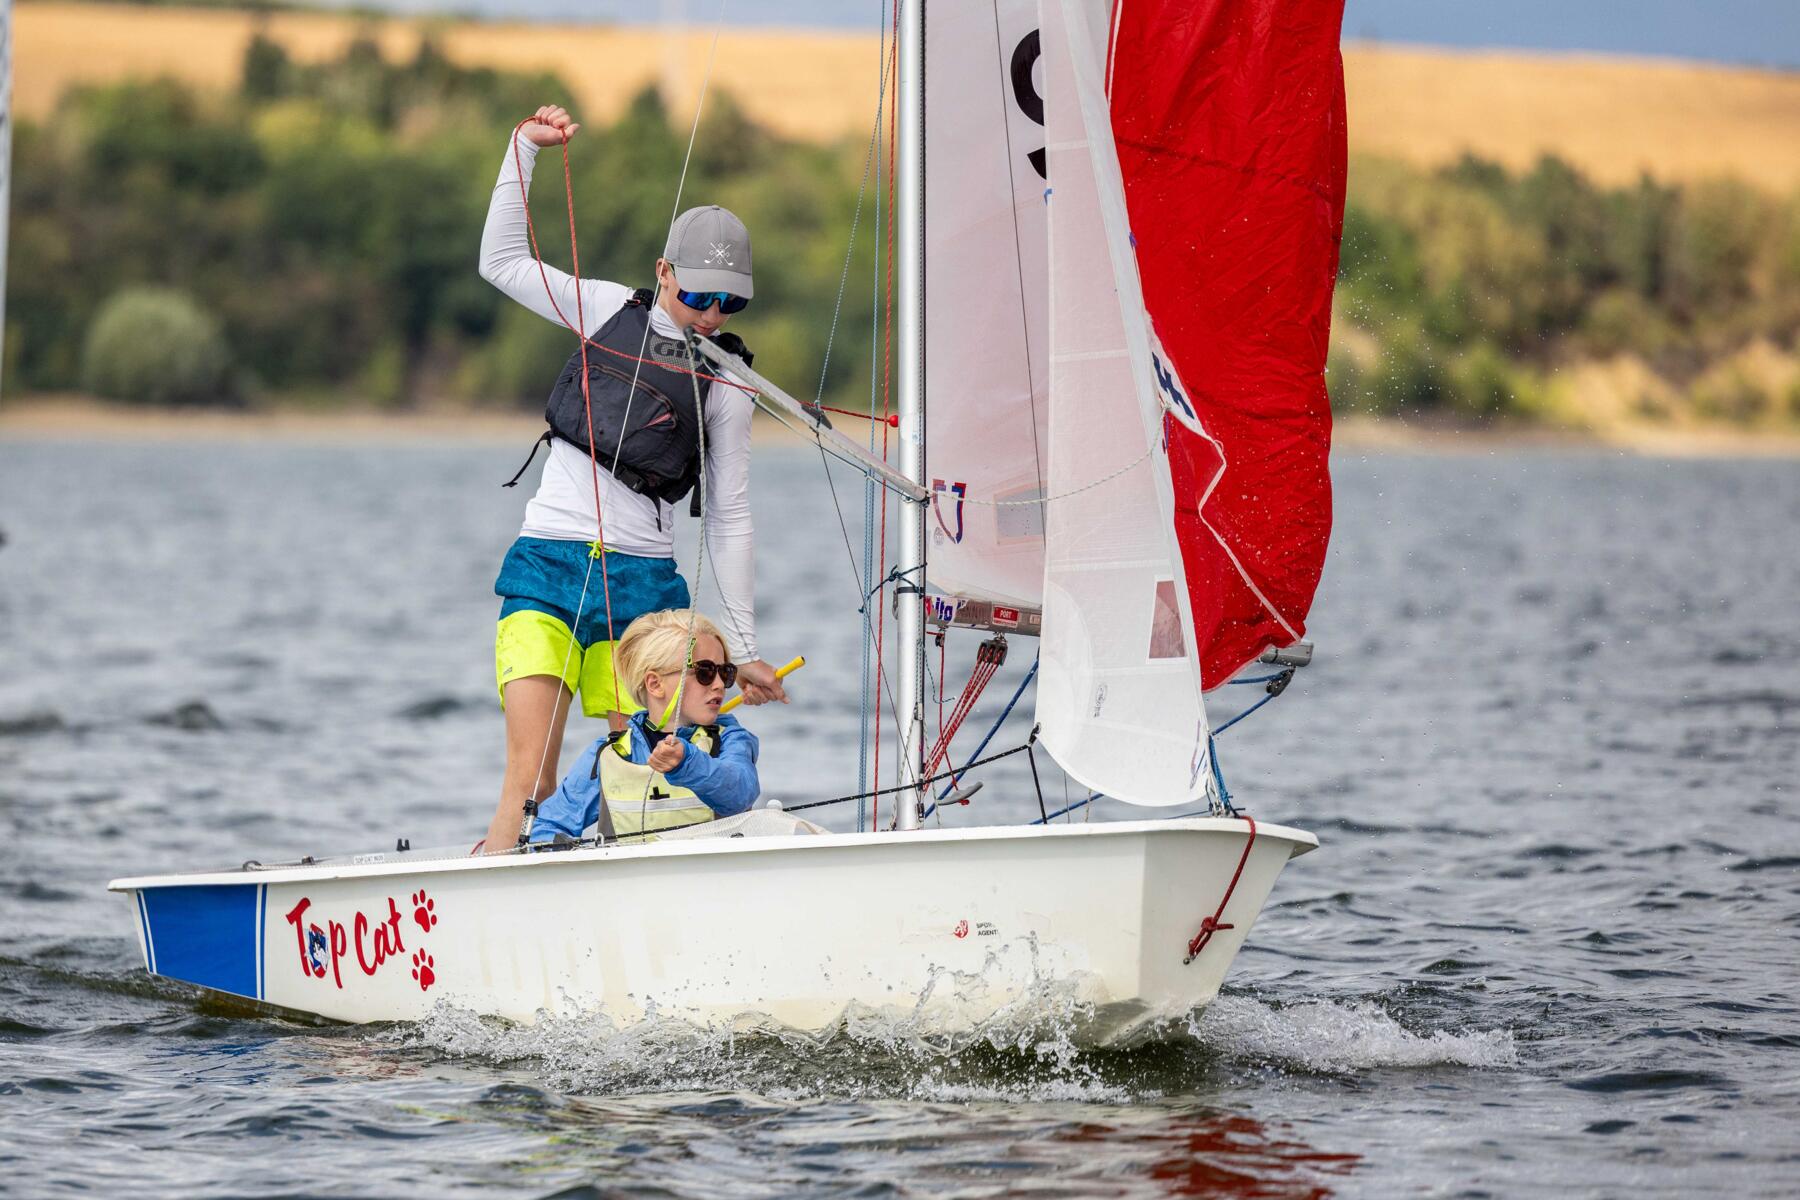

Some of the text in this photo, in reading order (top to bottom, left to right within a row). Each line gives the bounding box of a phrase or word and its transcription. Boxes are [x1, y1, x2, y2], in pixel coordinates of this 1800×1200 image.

[1000, 610, 1012, 619] PORT
[285, 897, 405, 989] Top Cat
